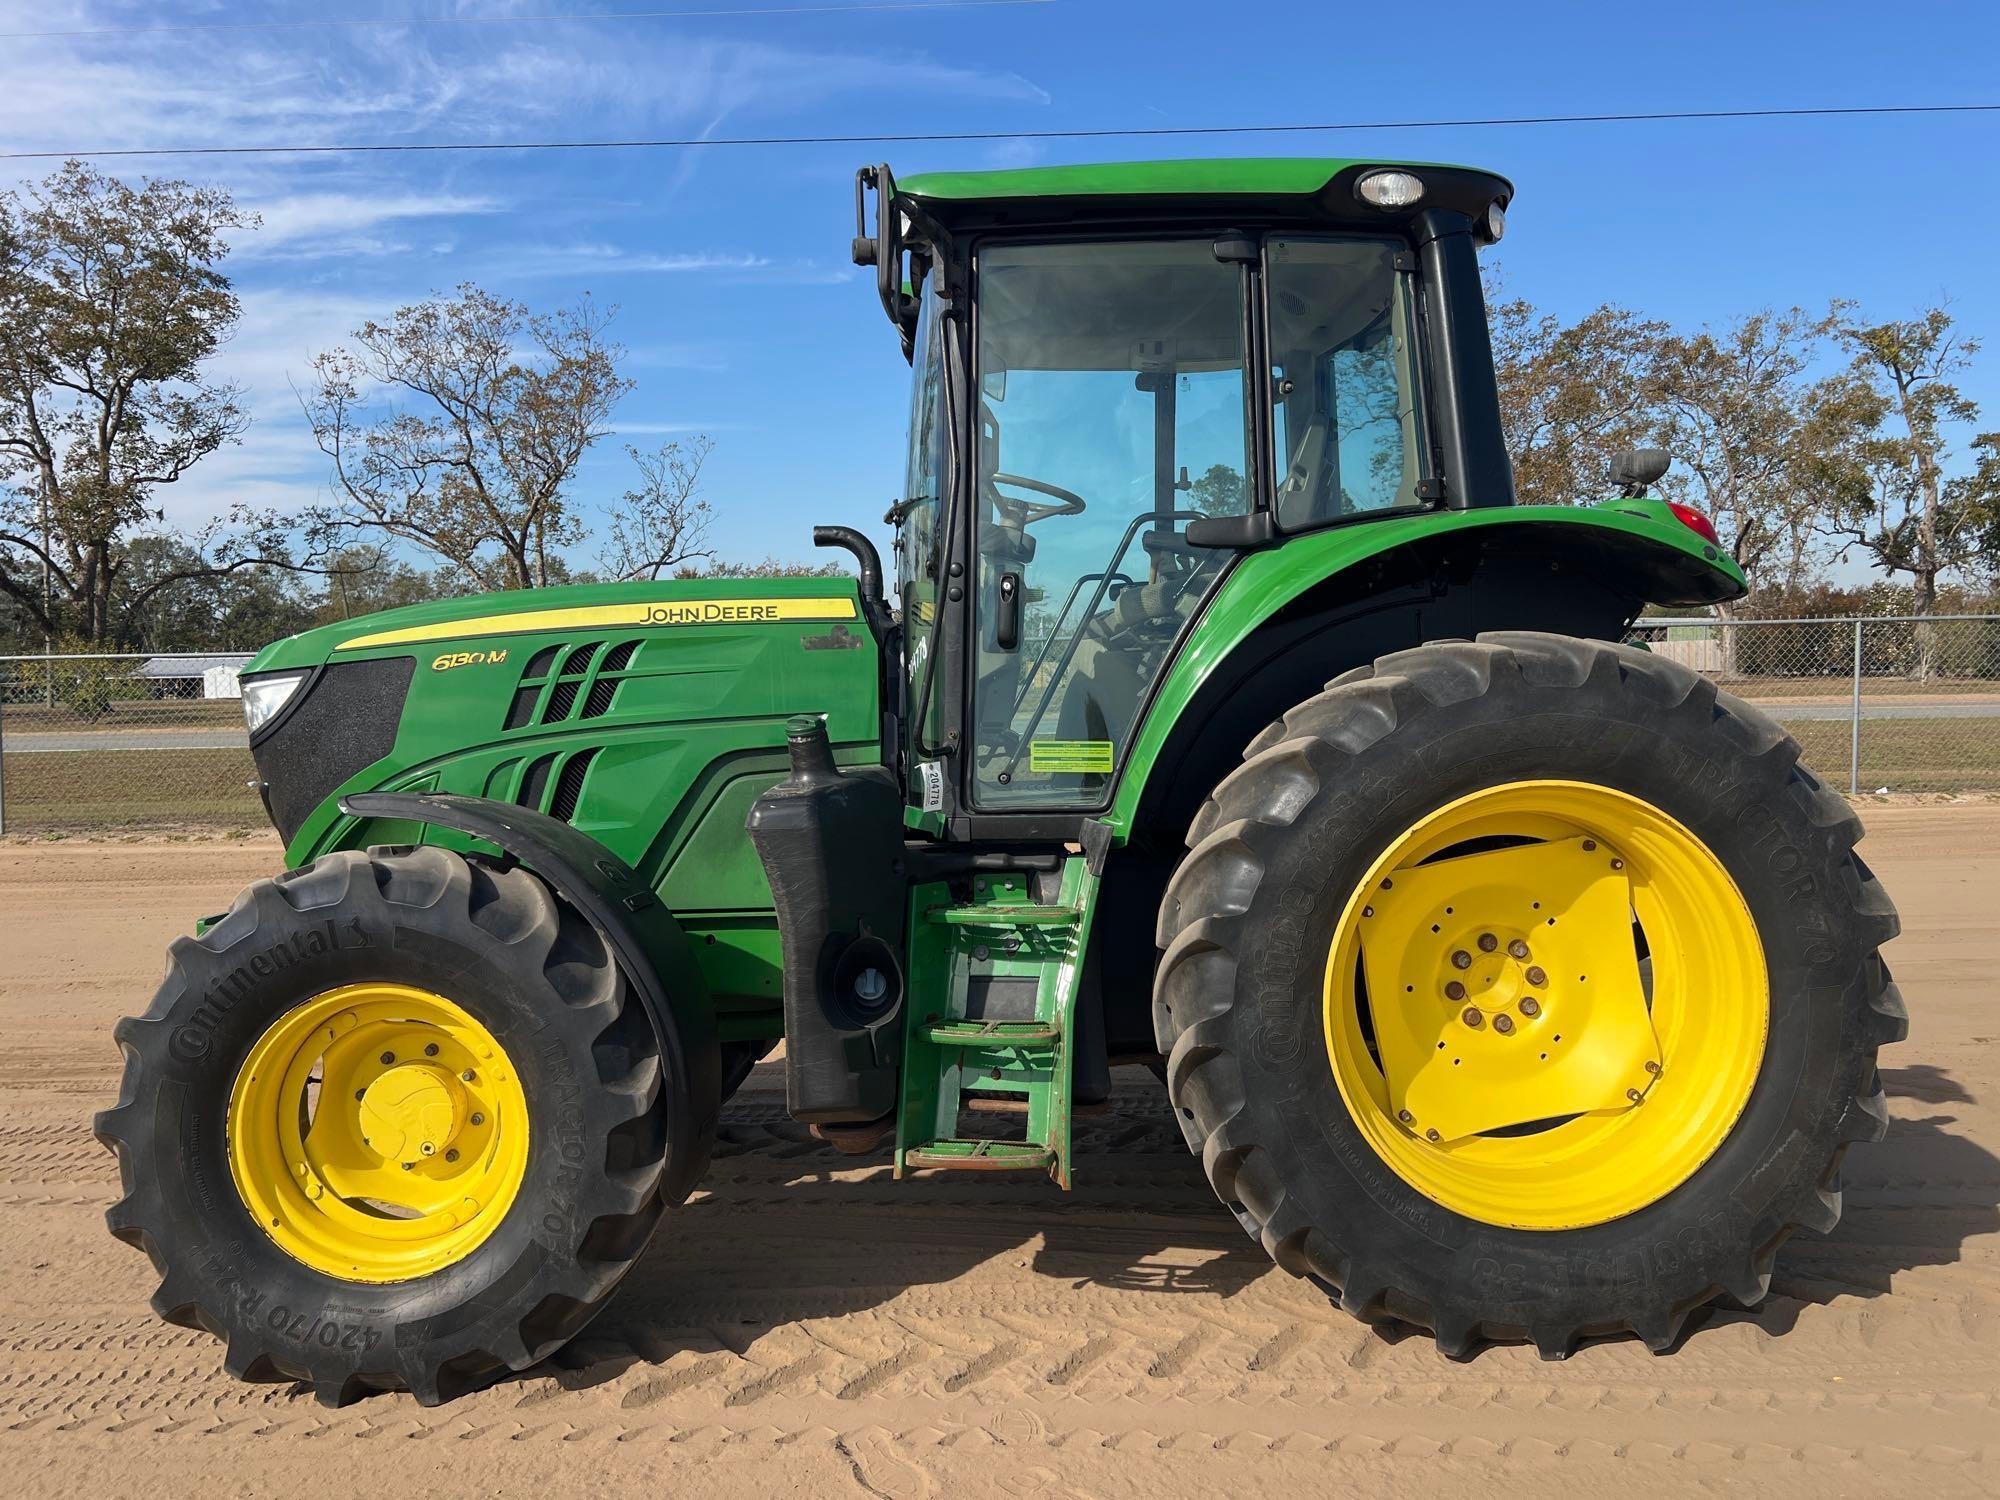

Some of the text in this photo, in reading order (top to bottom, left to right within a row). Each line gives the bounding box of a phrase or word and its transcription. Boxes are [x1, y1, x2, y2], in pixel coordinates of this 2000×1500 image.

[639, 604, 778, 623] JOHN DEERE
[930, 772, 941, 806] 204778
[168, 916, 342, 1067] Continental
[538, 1033, 587, 1189] TRACTOR
[264, 1297, 384, 1354] 420/70
